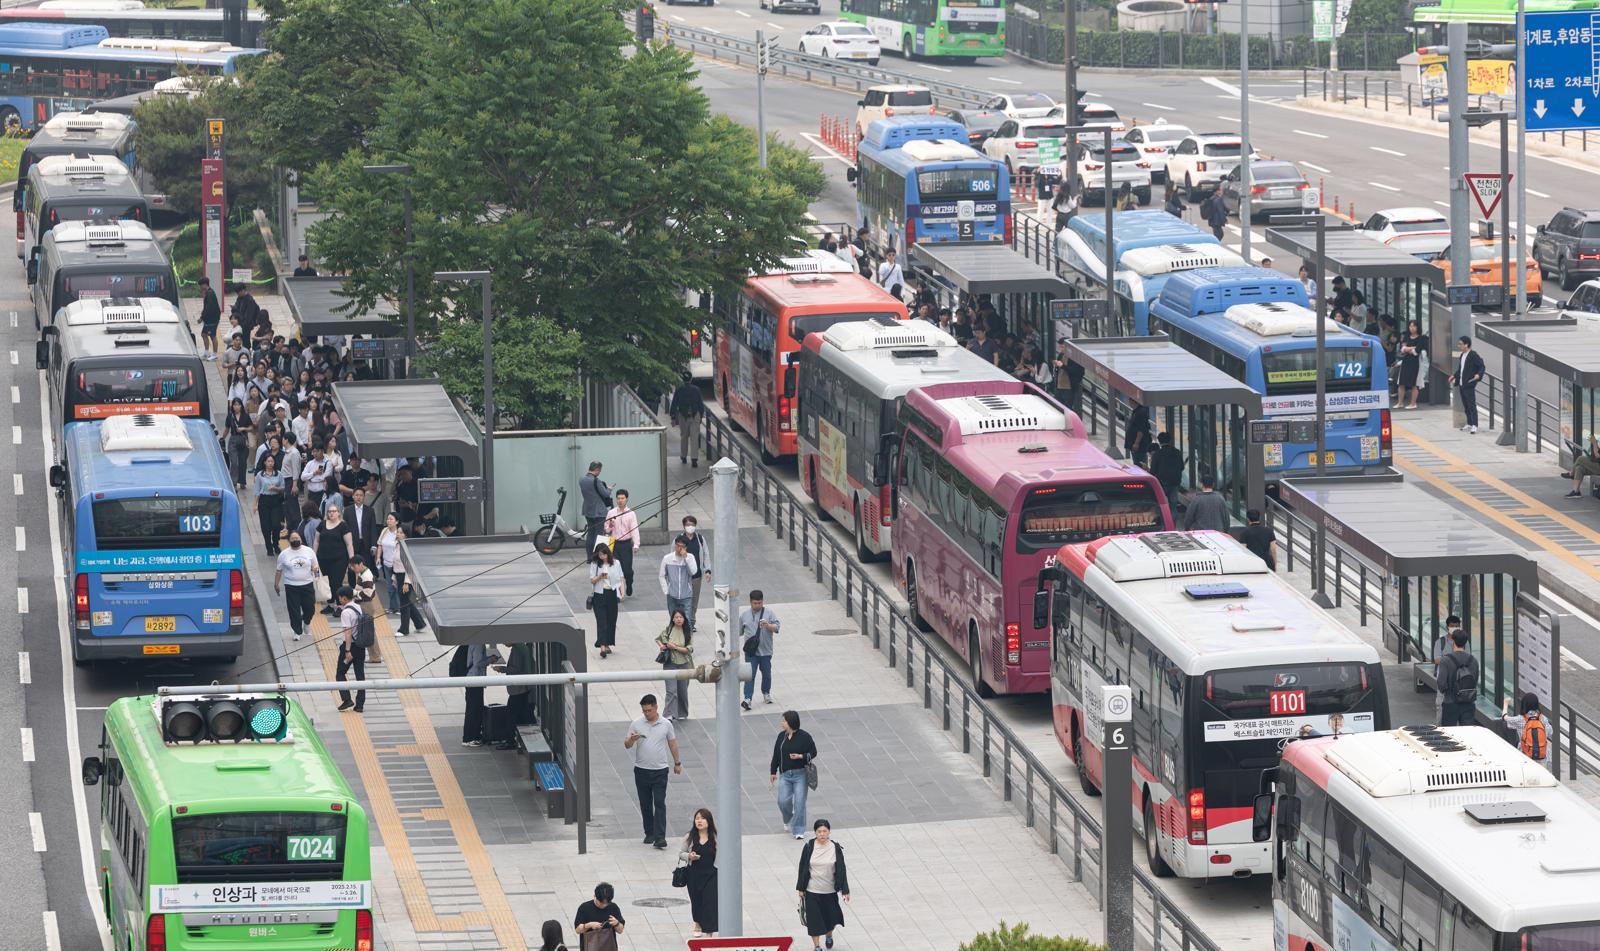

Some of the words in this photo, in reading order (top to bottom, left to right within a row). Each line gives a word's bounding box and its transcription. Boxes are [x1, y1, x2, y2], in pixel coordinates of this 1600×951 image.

[1527, 77, 1555, 89] 1차로
[1564, 76, 1593, 88] 2차로
[972, 180, 990, 191] 506
[1477, 180, 1501, 189] 천천히
[963, 224, 971, 234] 5
[1337, 363, 1363, 377] 742
[1329, 397, 1358, 406] 삼성증권
[183, 515, 212, 532] 103
[113, 557, 128, 566] 나는
[148, 555, 178, 565] 은행에서
[1271, 693, 1305, 712] 1101
[1234, 721, 1257, 729] 국가대표
[1259, 720, 1270, 728] 공식
[1271, 719, 1295, 727] 매트리스
[1112, 727, 1125, 745] 6
[1233, 729, 1265, 737] 베스트슬립
[1266, 728, 1293, 737] 체인지업!
[289, 837, 334, 858] 7024
[212, 886, 257, 903] 인상파
[261, 886, 286, 895] 모네에서
[287, 886, 311, 894] 미국으로
[1300, 878, 1319, 922] 8100
[249, 927, 278, 937] 원버스
